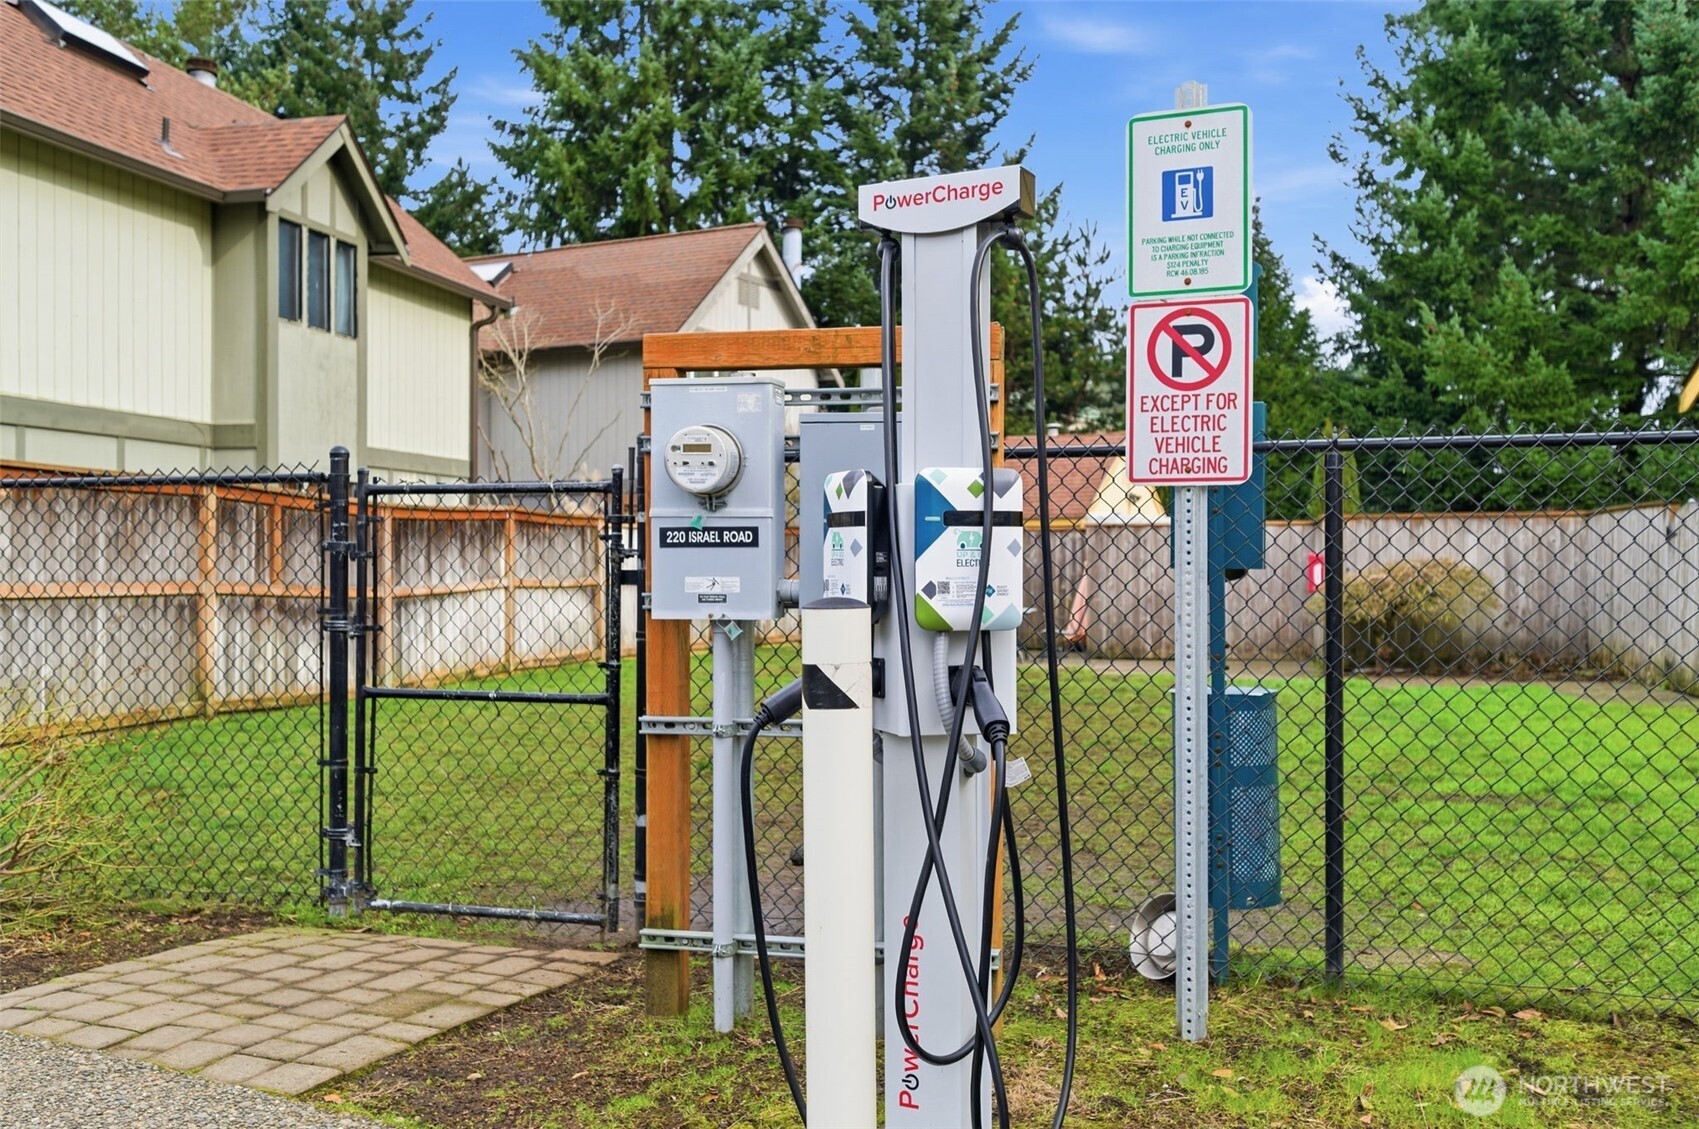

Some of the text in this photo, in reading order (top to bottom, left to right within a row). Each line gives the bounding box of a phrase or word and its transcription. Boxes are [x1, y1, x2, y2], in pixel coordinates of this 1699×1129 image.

[1148, 127, 1227, 145] ELECTRIC VEHICLE
[1154, 140, 1221, 156] CHARGING ONLY
[873, 181, 1004, 212] PowerCharge
[1141, 230, 1235, 245] PARKING WHILE NOT CONNECTED
[1160, 243, 1190, 253] CHARGING
[1190, 240, 1224, 250] EQUIPMENT
[1164, 252, 1189, 260] PARKING
[1190, 249, 1225, 258] INFRACTION
[1182, 259, 1208, 267] PENALTY
[1140, 392, 1238, 413] EXCEPT FOR
[1150, 413, 1227, 433] ELECTRIC
[1154, 435, 1222, 454] VEHICLE
[1148, 456, 1228, 475] CHARGING
[666, 530, 753, 543] 220 ISRAEL ROAD
